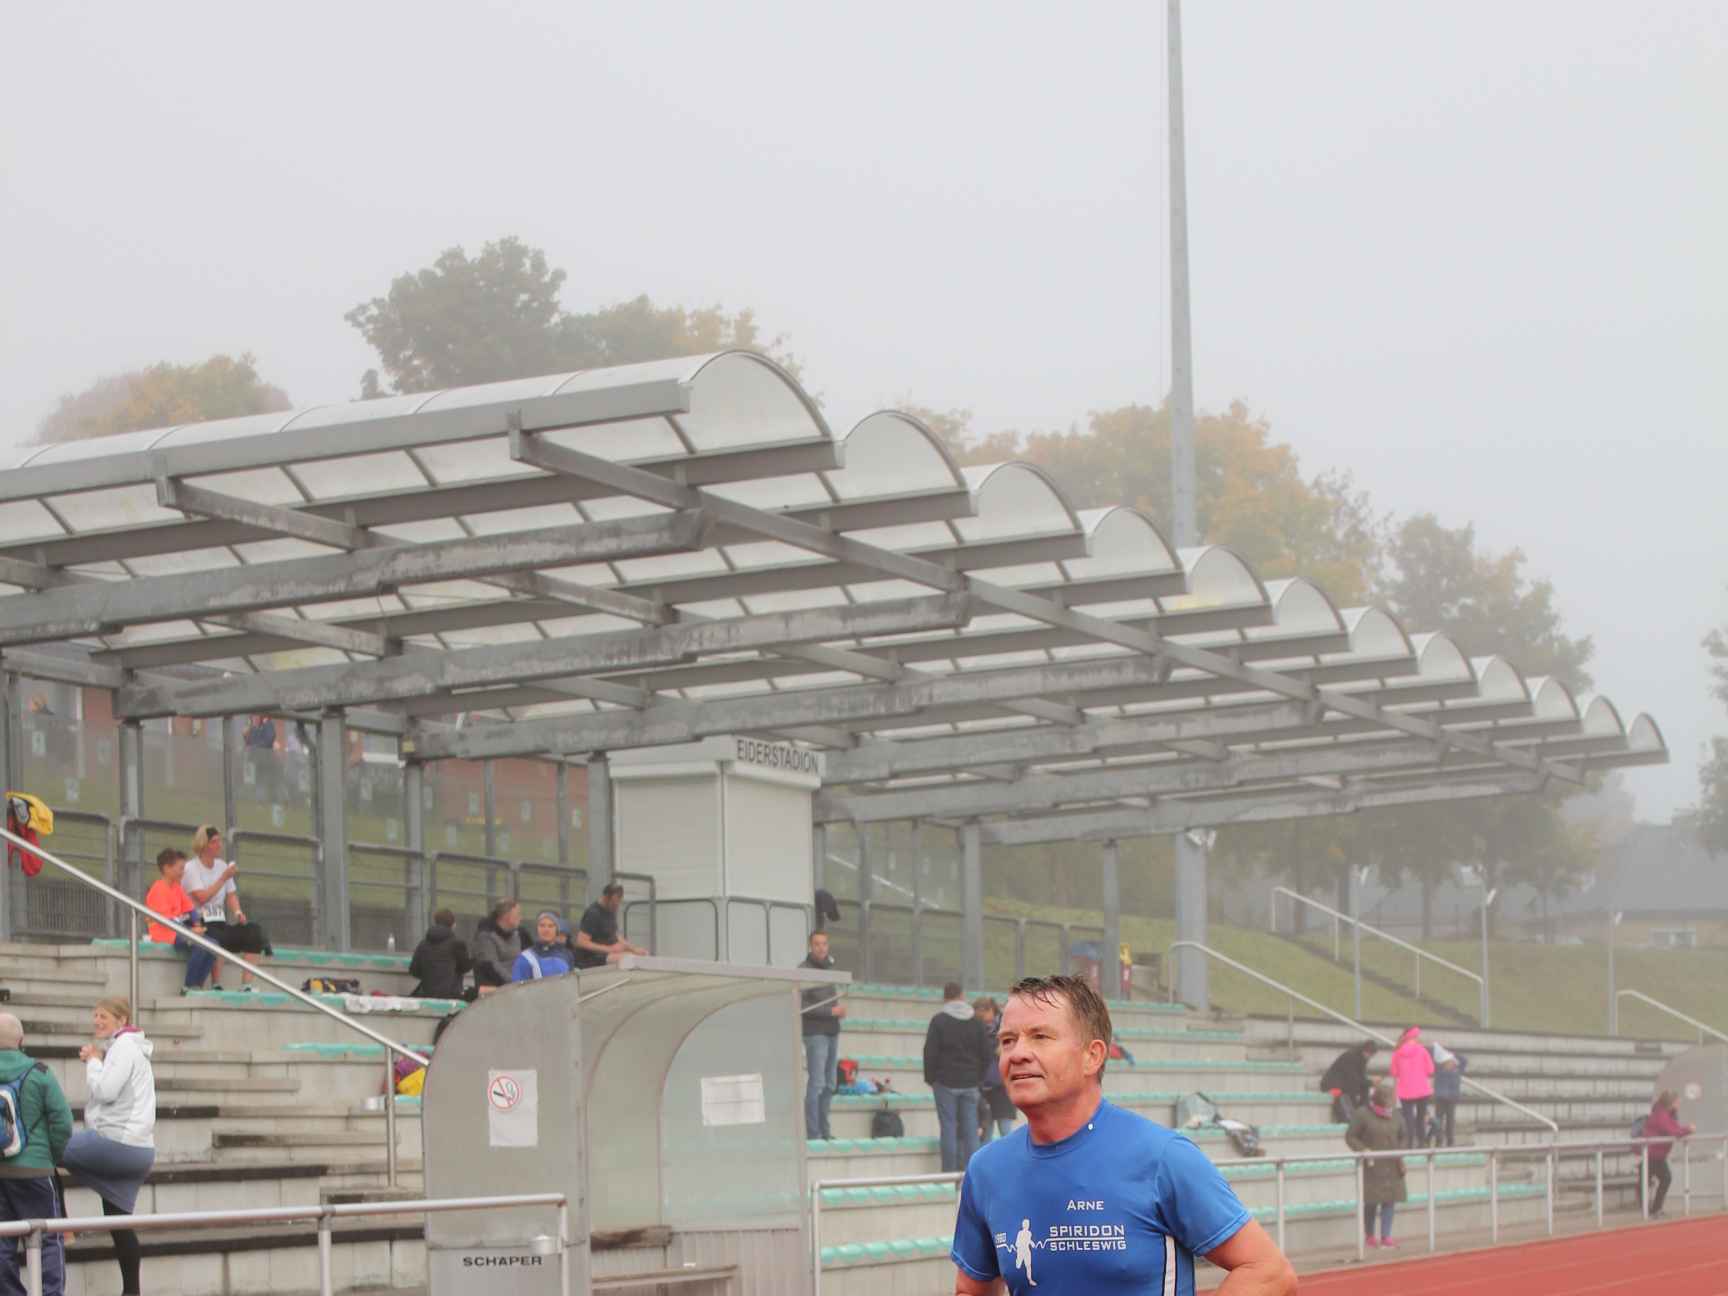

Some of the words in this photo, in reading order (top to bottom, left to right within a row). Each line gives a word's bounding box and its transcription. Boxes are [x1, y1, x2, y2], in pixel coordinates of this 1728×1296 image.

[737, 739, 819, 775] EIDERSTADION
[1066, 1199, 1105, 1211] ARNE
[1049, 1225, 1125, 1237] SPIRIDON
[1049, 1240, 1127, 1252] SCHLESWIG
